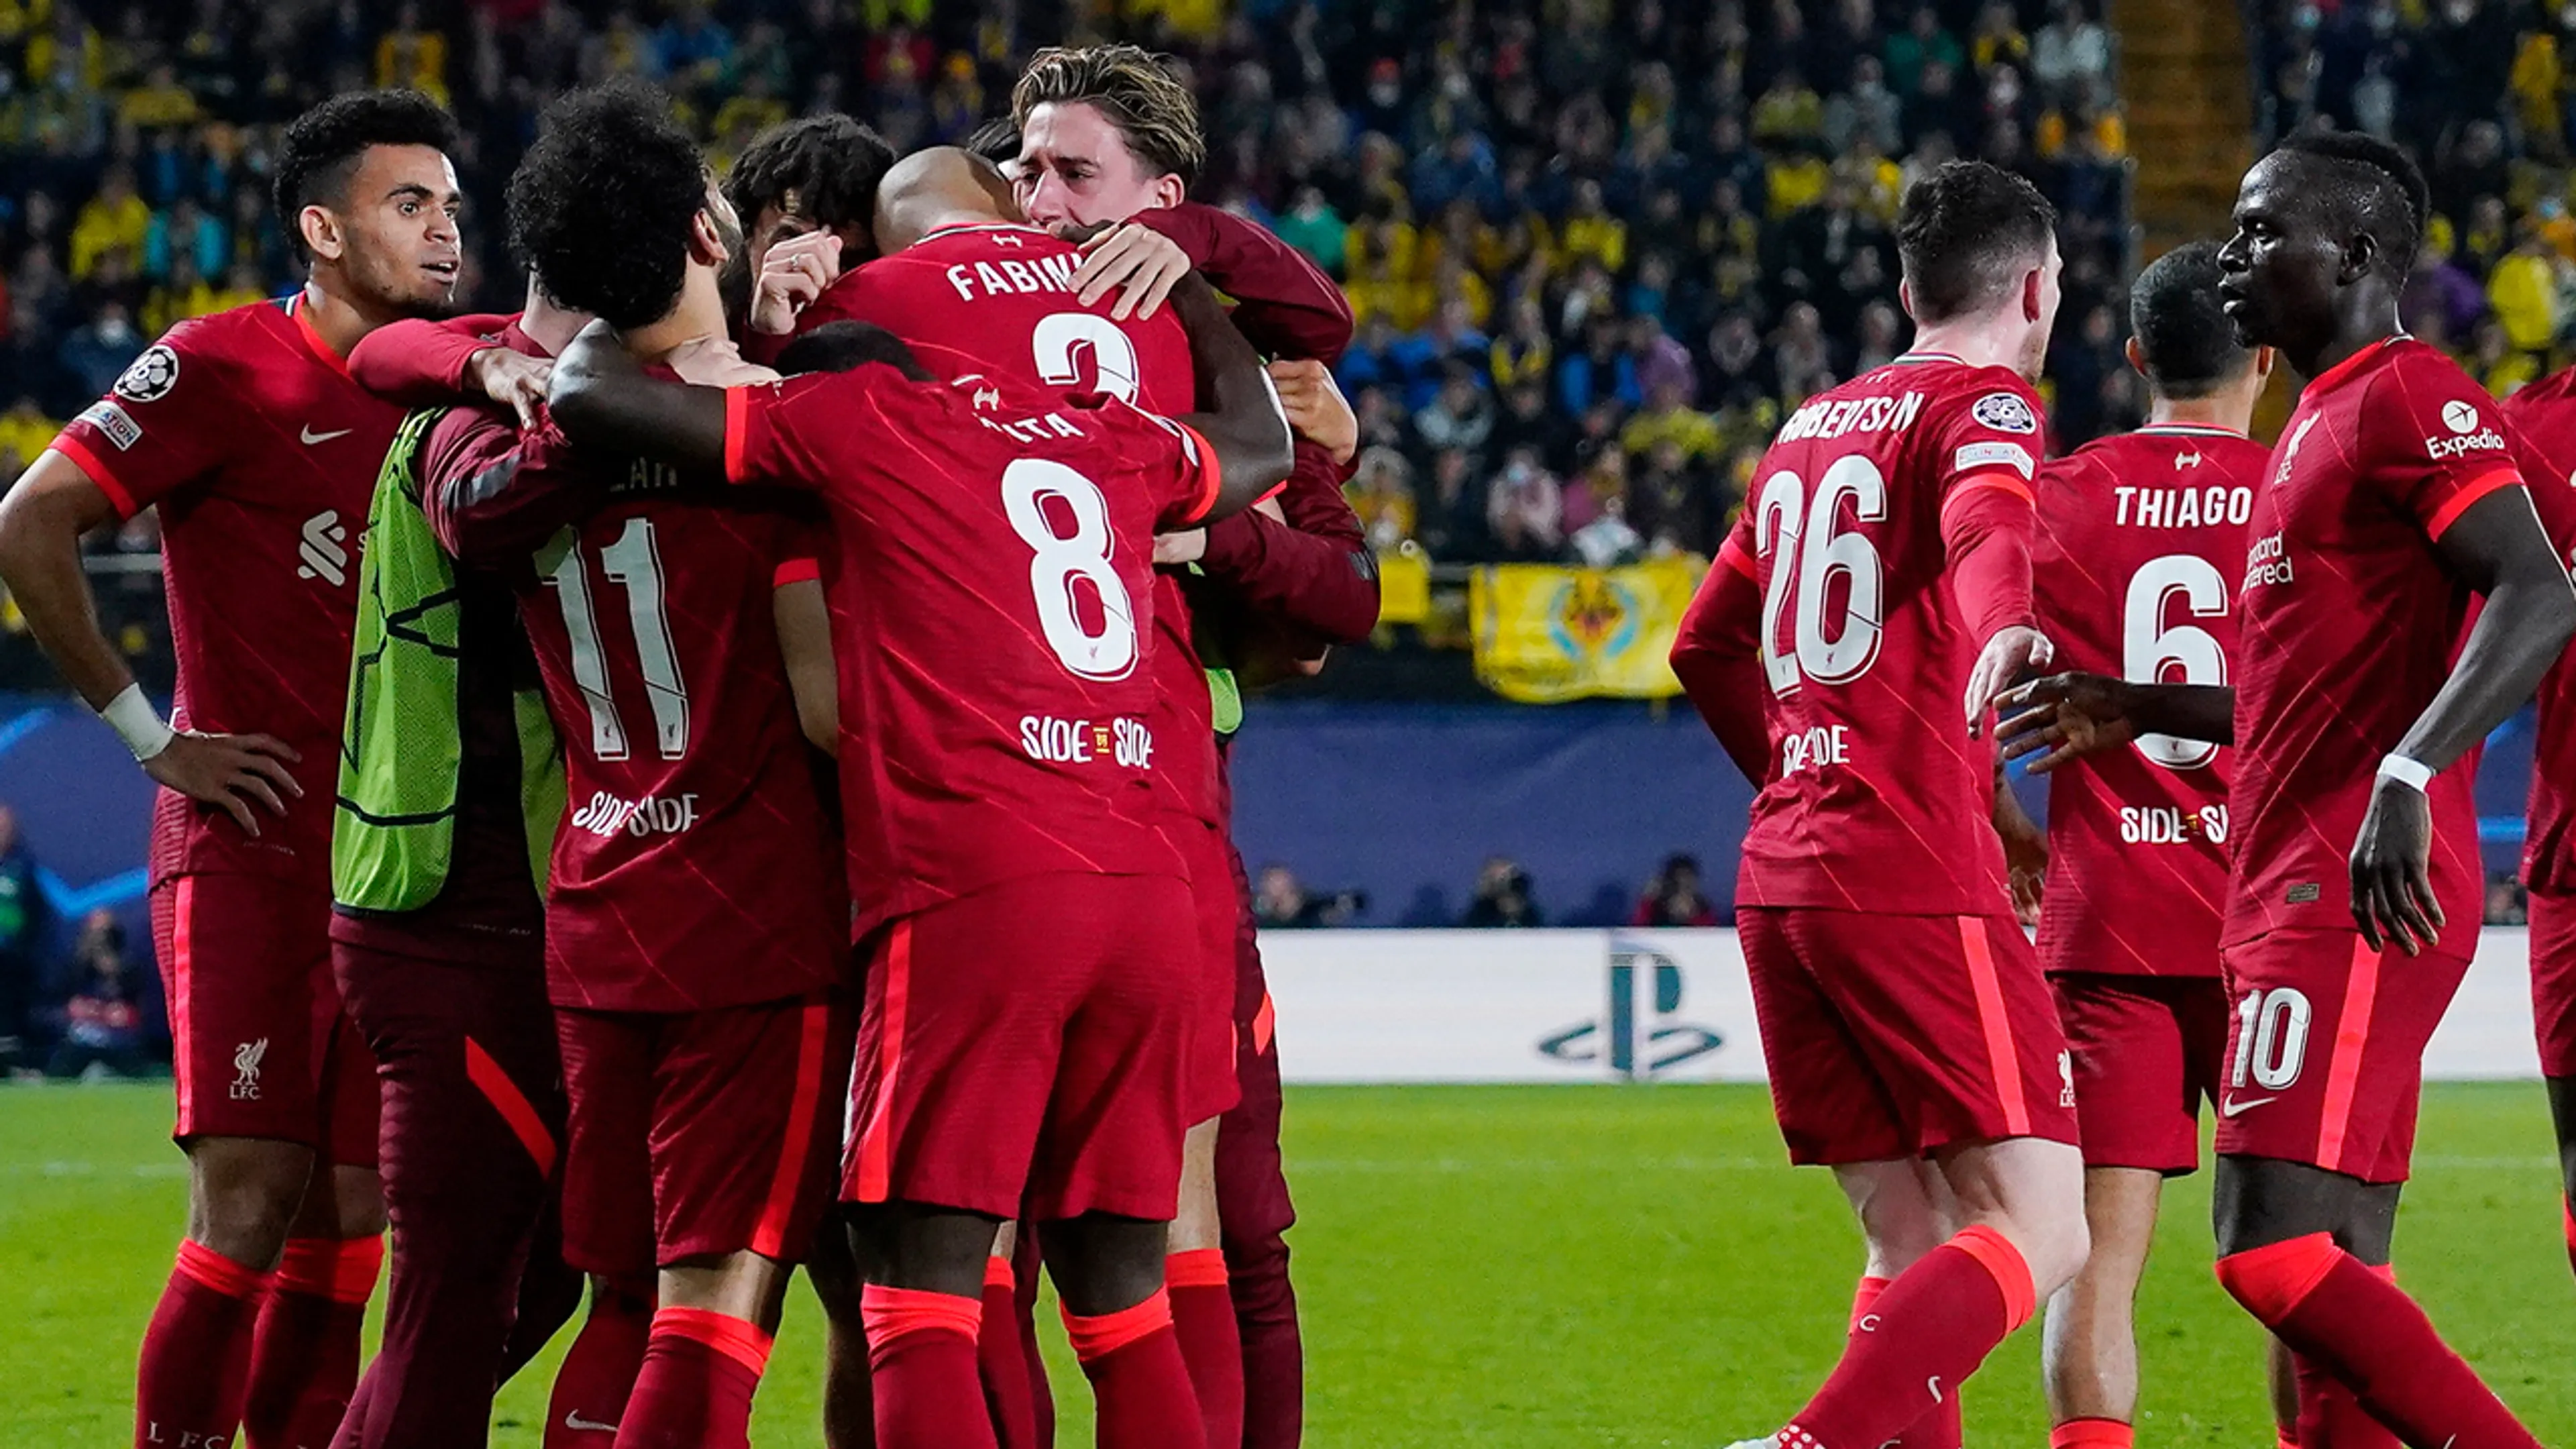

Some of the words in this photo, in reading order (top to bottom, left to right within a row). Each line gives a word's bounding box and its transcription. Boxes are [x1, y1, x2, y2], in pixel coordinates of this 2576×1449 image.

[947, 252, 1083, 302] FABIN
[1777, 390, 1925, 445] ROBERTSN
[2426, 427, 2505, 460] Expedia
[2114, 486, 2253, 528] THIAGO
[1002, 458, 1140, 682] 8
[1756, 454, 1887, 699] 26
[532, 517, 689, 760] 11
[2123, 554, 2229, 770] 6
[1020, 716, 1092, 763] SIDE
[1113, 717, 1154, 769] SIDE
[2200, 804, 2229, 844] SI
[2232, 987, 2312, 1090] 10
